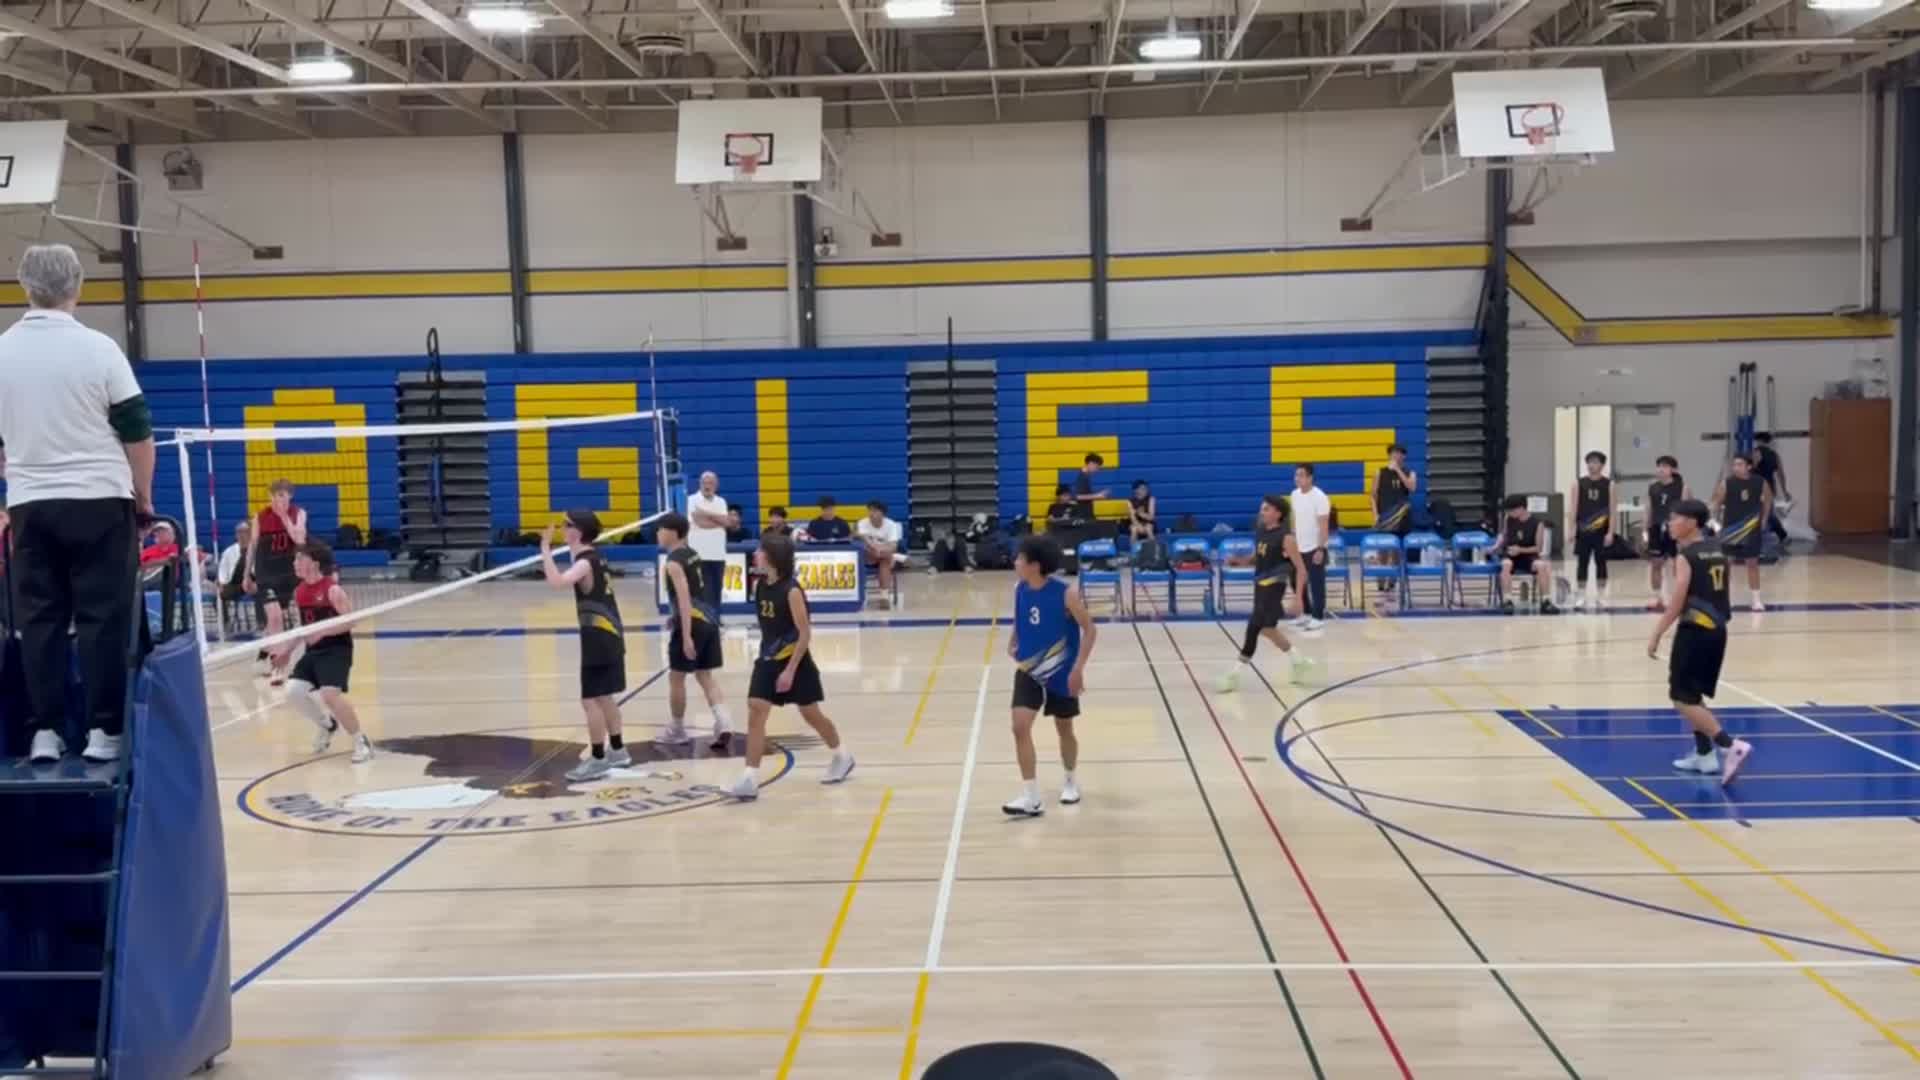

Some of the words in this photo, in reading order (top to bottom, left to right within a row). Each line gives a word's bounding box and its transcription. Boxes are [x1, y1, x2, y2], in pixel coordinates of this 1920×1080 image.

[798, 563, 856, 590] EAGLES
[1028, 606, 1041, 625] 3
[344, 815, 412, 829] OF
[424, 814, 528, 830] THE
